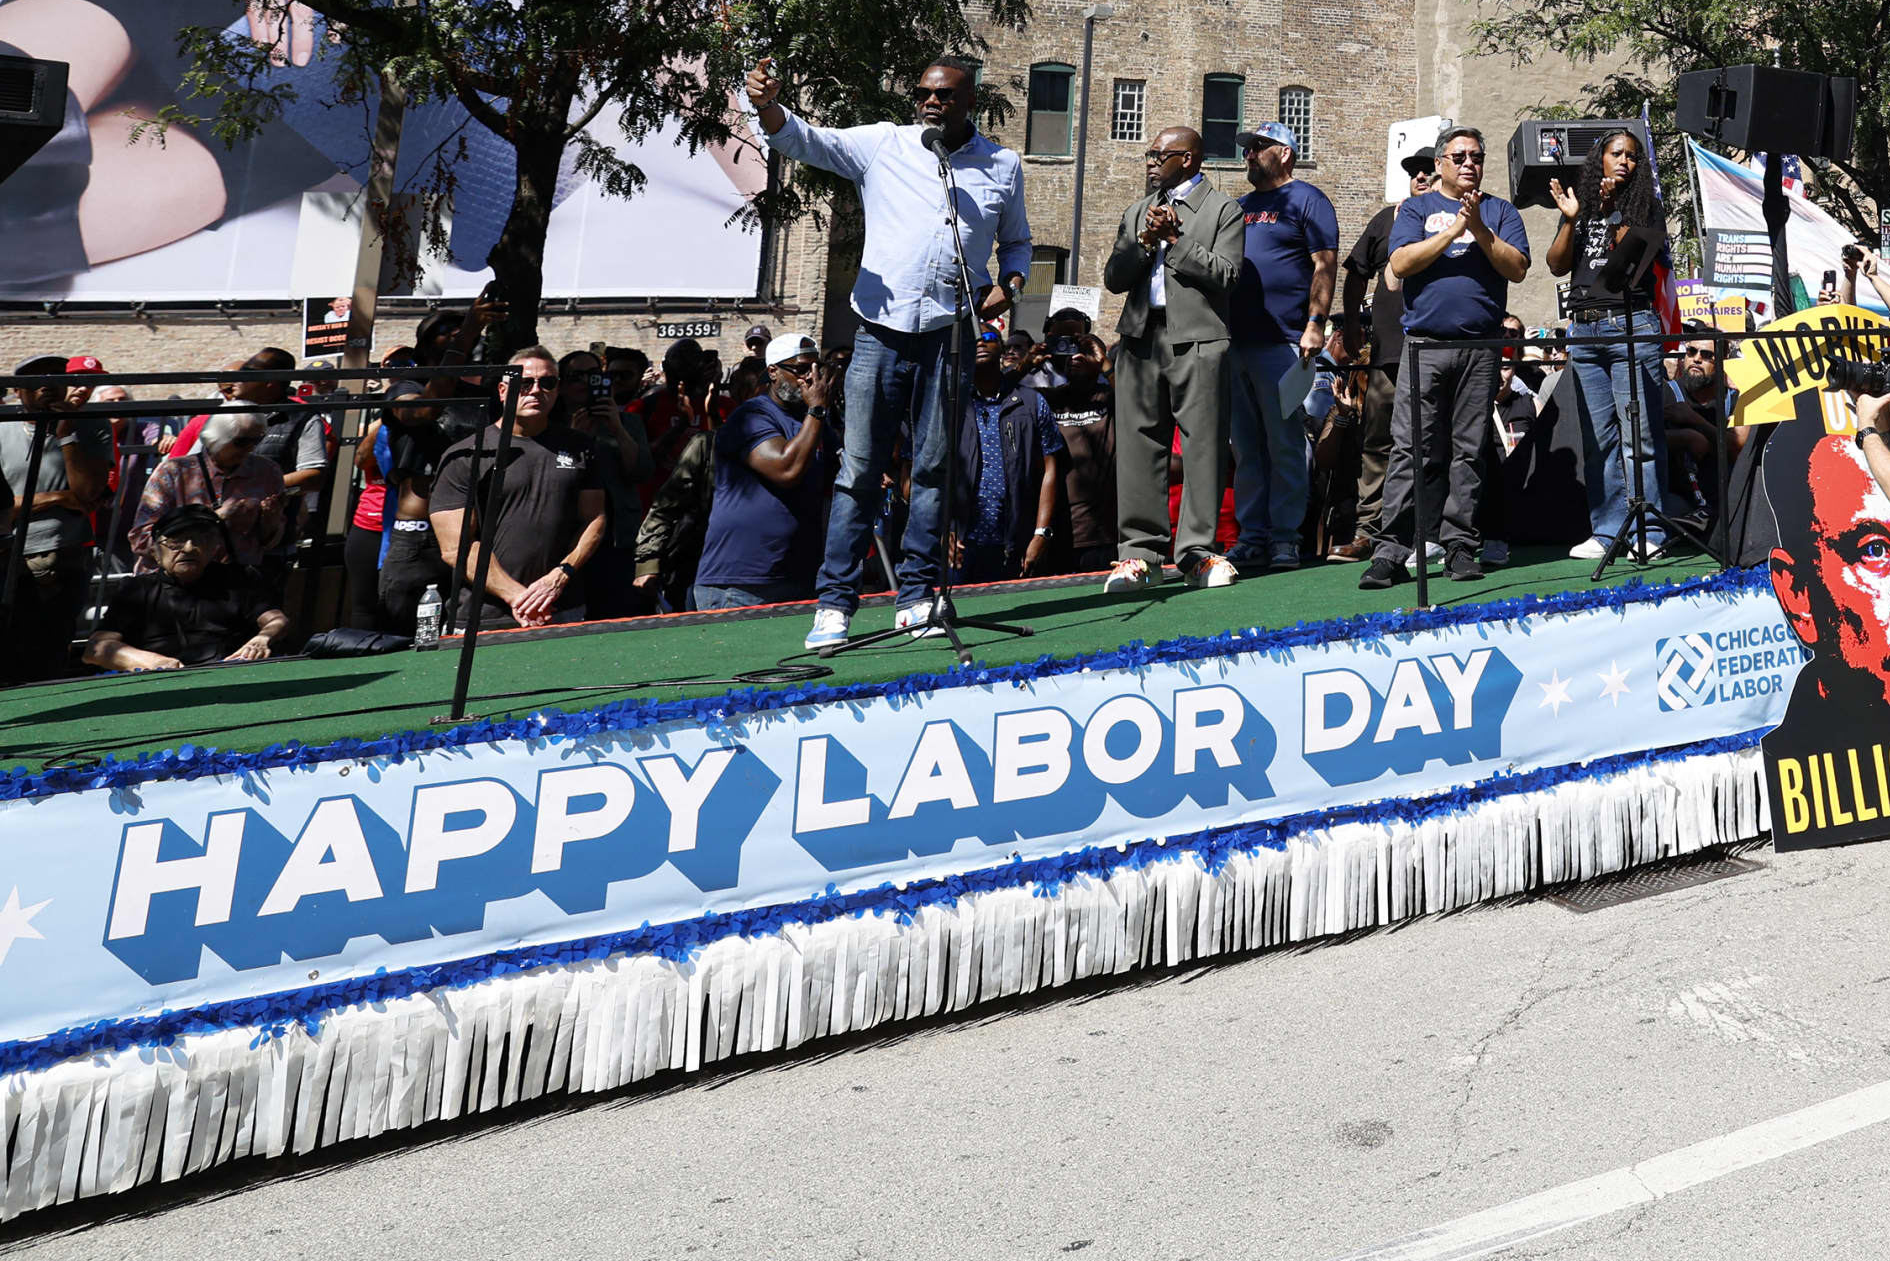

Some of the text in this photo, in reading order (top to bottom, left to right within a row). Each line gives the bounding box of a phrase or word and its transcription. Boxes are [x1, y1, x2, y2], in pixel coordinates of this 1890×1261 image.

[1718, 233, 1744, 243] TRANS
[1715, 243, 1747, 254] RIGHTS
[1715, 253, 1733, 263] ARE
[1714, 262, 1743, 273] HUMAN
[1713, 272, 1745, 283] RIGHTS
[1696, 296, 1709, 305] FO
[1680, 306, 1743, 317] ILLIONAIRES
[1717, 646, 1804, 677] FEDERATI
[1719, 674, 1783, 702] LABOR
[106, 648, 1496, 942] HAPPY LABOR DAY
